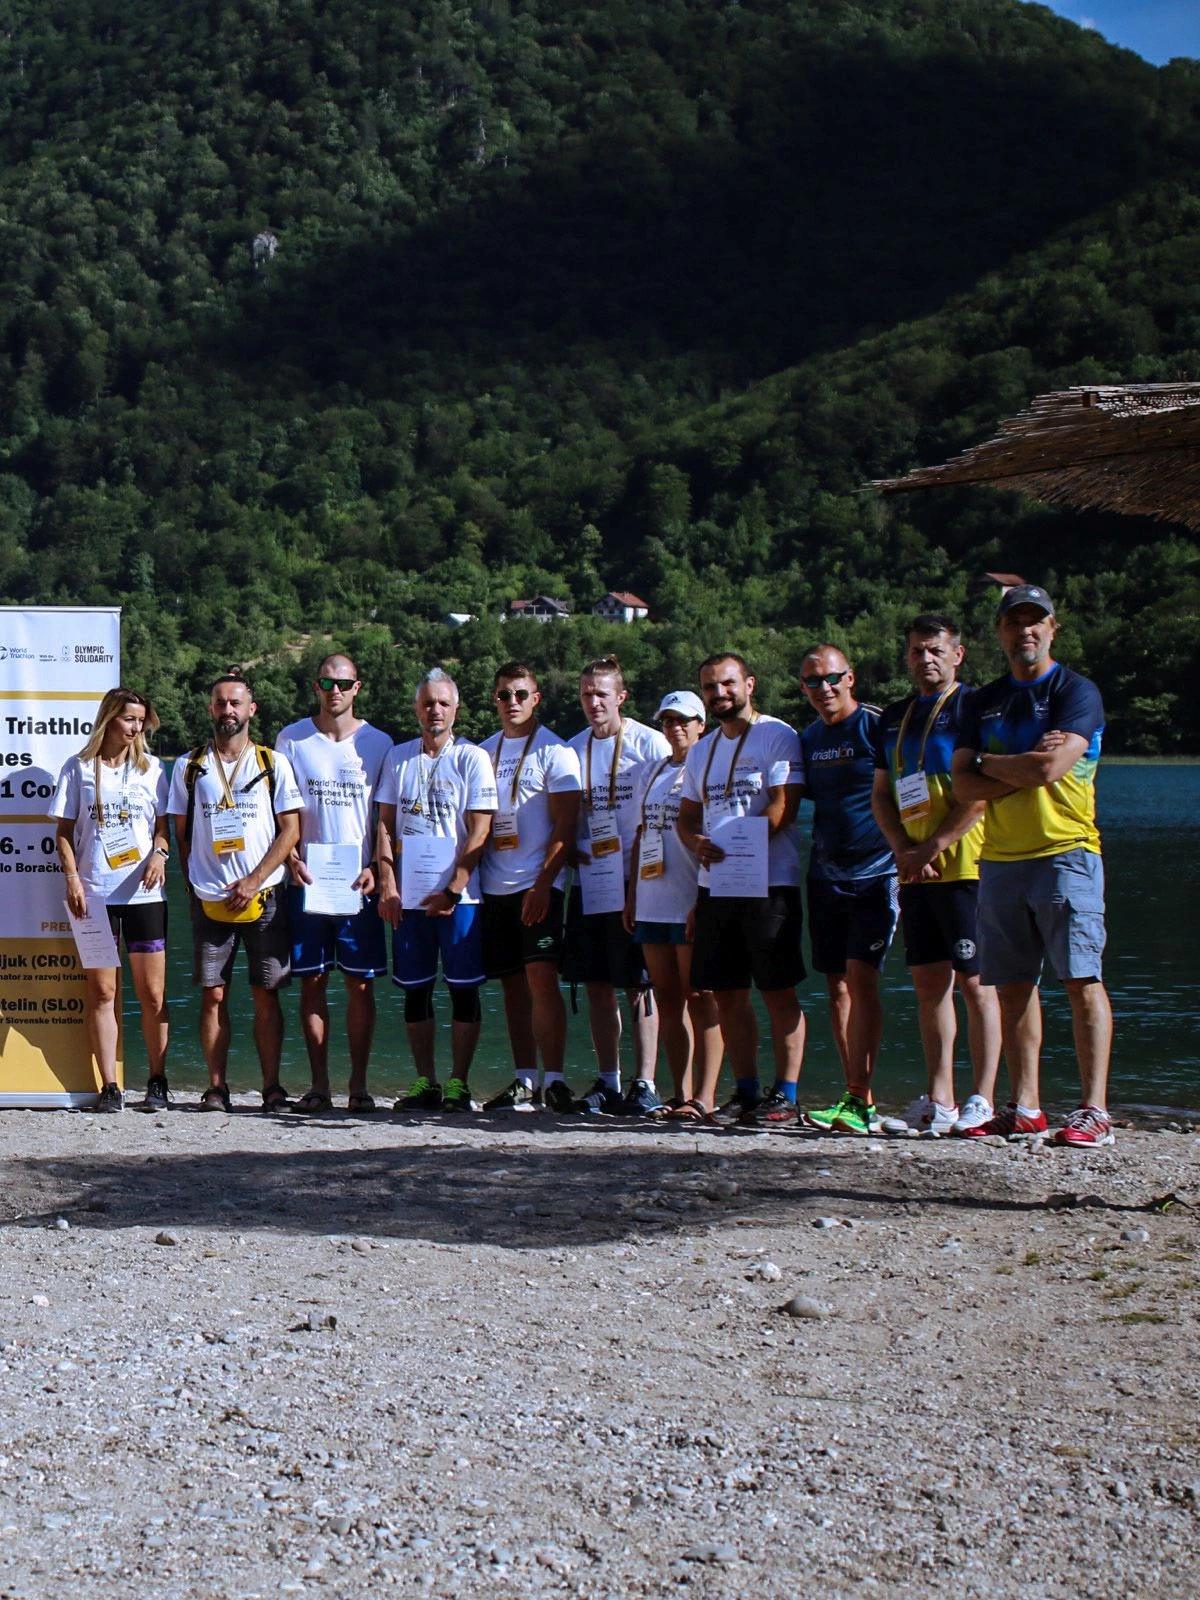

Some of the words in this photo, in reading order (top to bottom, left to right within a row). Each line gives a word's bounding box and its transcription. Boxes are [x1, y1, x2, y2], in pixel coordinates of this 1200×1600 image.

[75, 655, 113, 663] SOLIDARITY
[5, 717, 93, 735] Triathlo
[812, 747, 854, 760] triathlon
[0, 781, 14, 798] 1
[21, 781, 56, 798] Co
[307, 779, 330, 787] World
[332, 781, 364, 789] Triathlon
[308, 788, 341, 797] Coaches
[343, 790, 364, 799] Level
[324, 798, 352, 807] Course
[41, 837, 57, 855] 0
[31, 954, 76, 969] (CRO)
[35, 973, 61, 982] razvoj
[41, 998, 84, 1013] (SLO)
[5, 1017, 50, 1025] Slovenske
